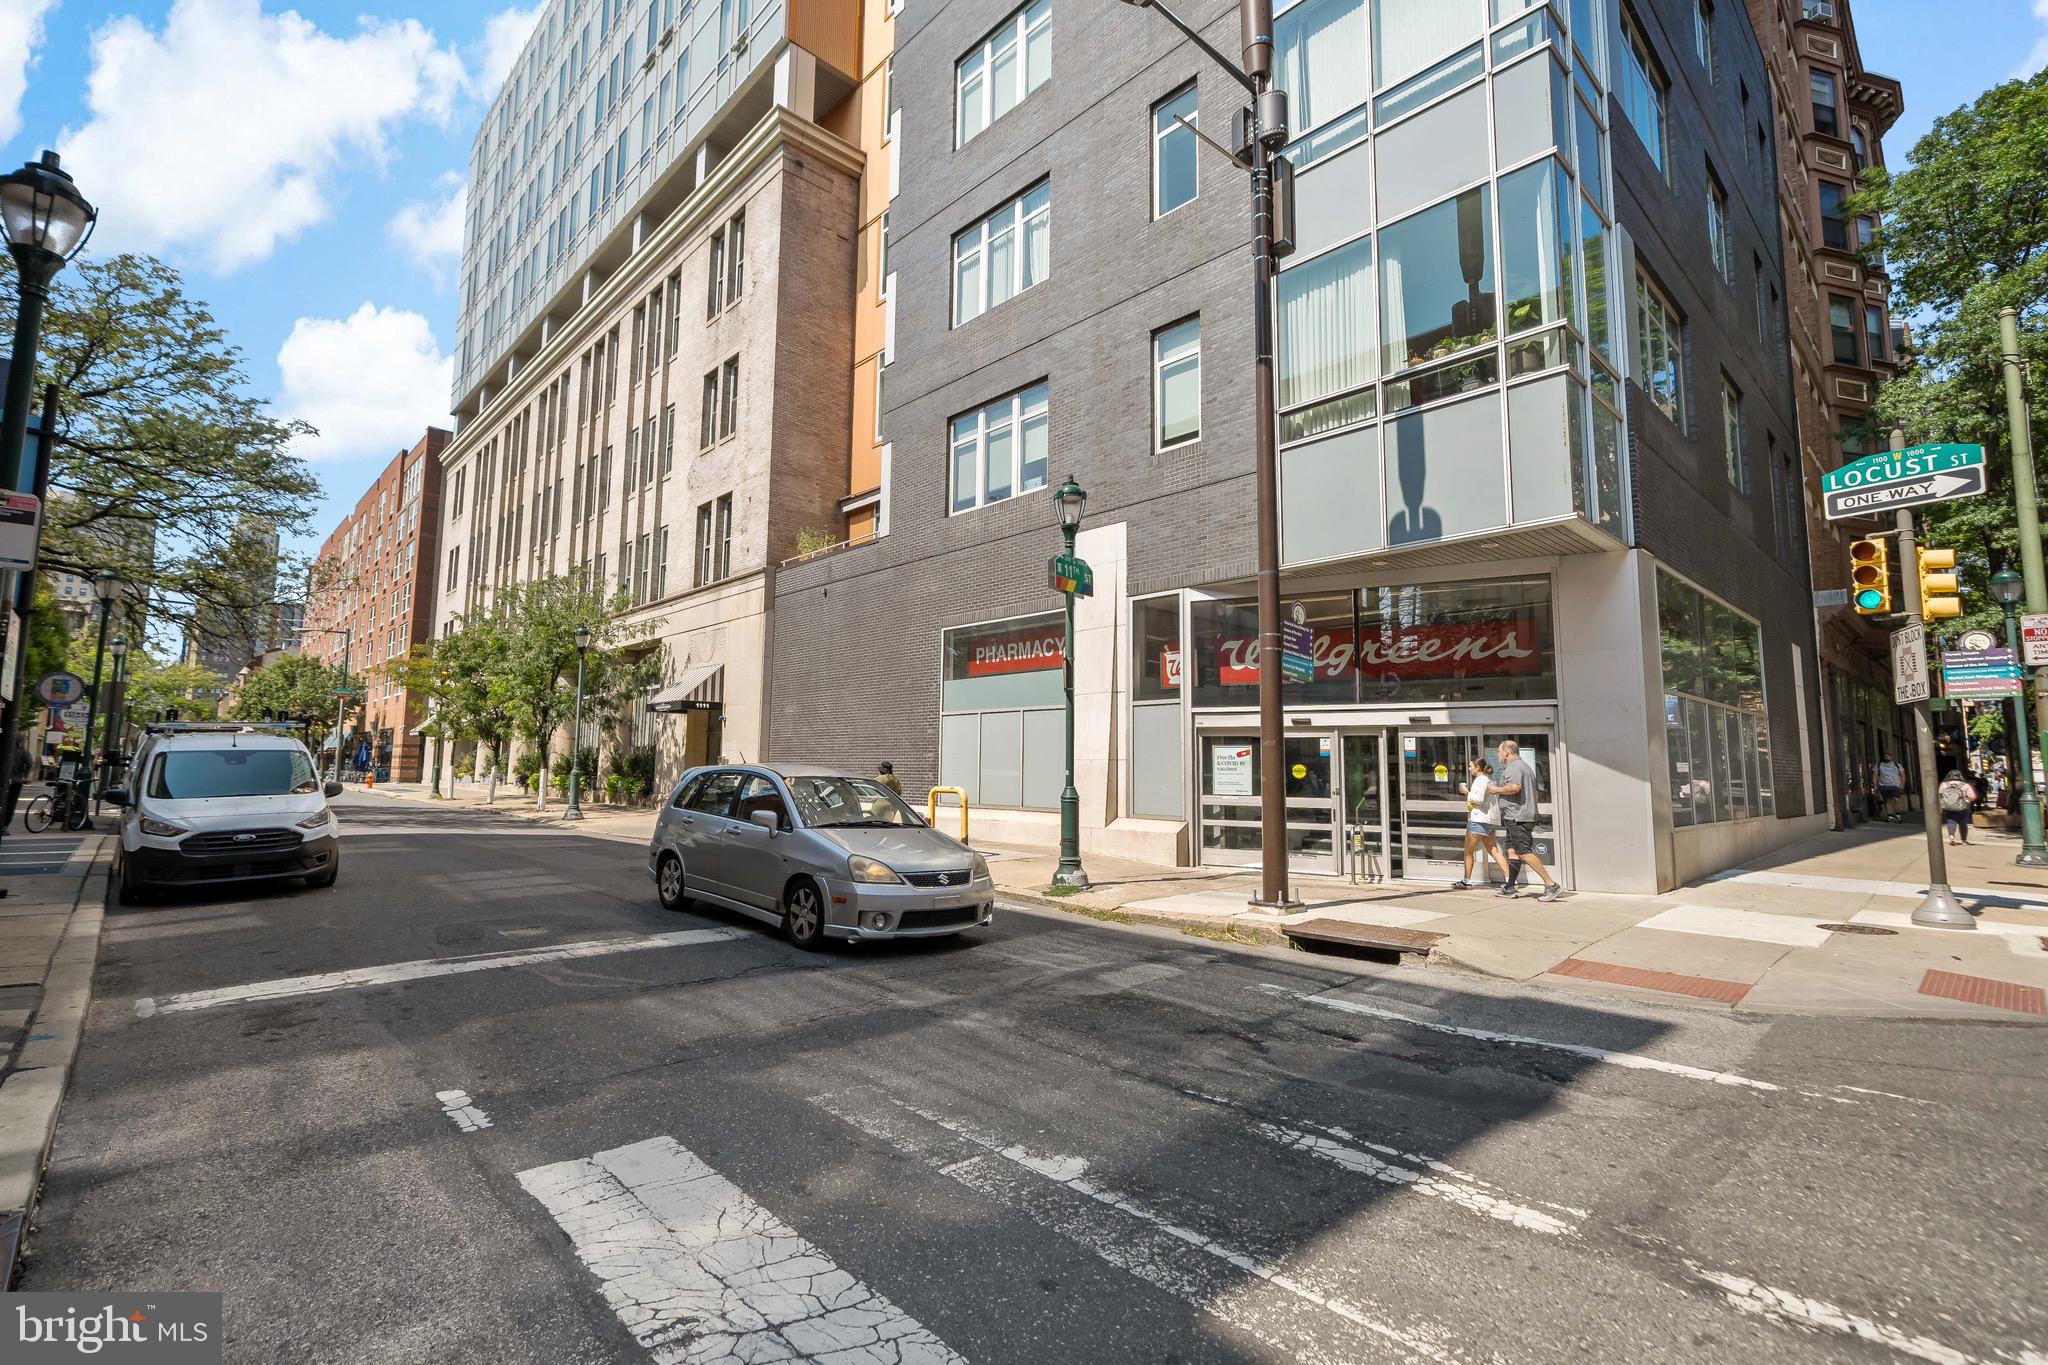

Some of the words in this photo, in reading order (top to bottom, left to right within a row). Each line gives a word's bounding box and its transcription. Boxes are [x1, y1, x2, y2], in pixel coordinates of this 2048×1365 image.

[1872, 456, 1888, 464] 1100
[1892, 452, 1902, 461] W
[1906, 448, 1925, 457] 1000
[1830, 454, 1938, 490] LOCUST
[1951, 452, 1968, 467] ST
[1843, 492, 1882, 508] ONE
[1888, 482, 1933, 498] WAY
[1084, 573, 1092, 583] ST
[2034, 628, 2048, 636] NO
[975, 637, 1066, 664] PHARMACY
[1220, 631, 1534, 677] Wlgreens
[1897, 685, 1910, 700] THE
[1911, 681, 1926, 698] BOX
